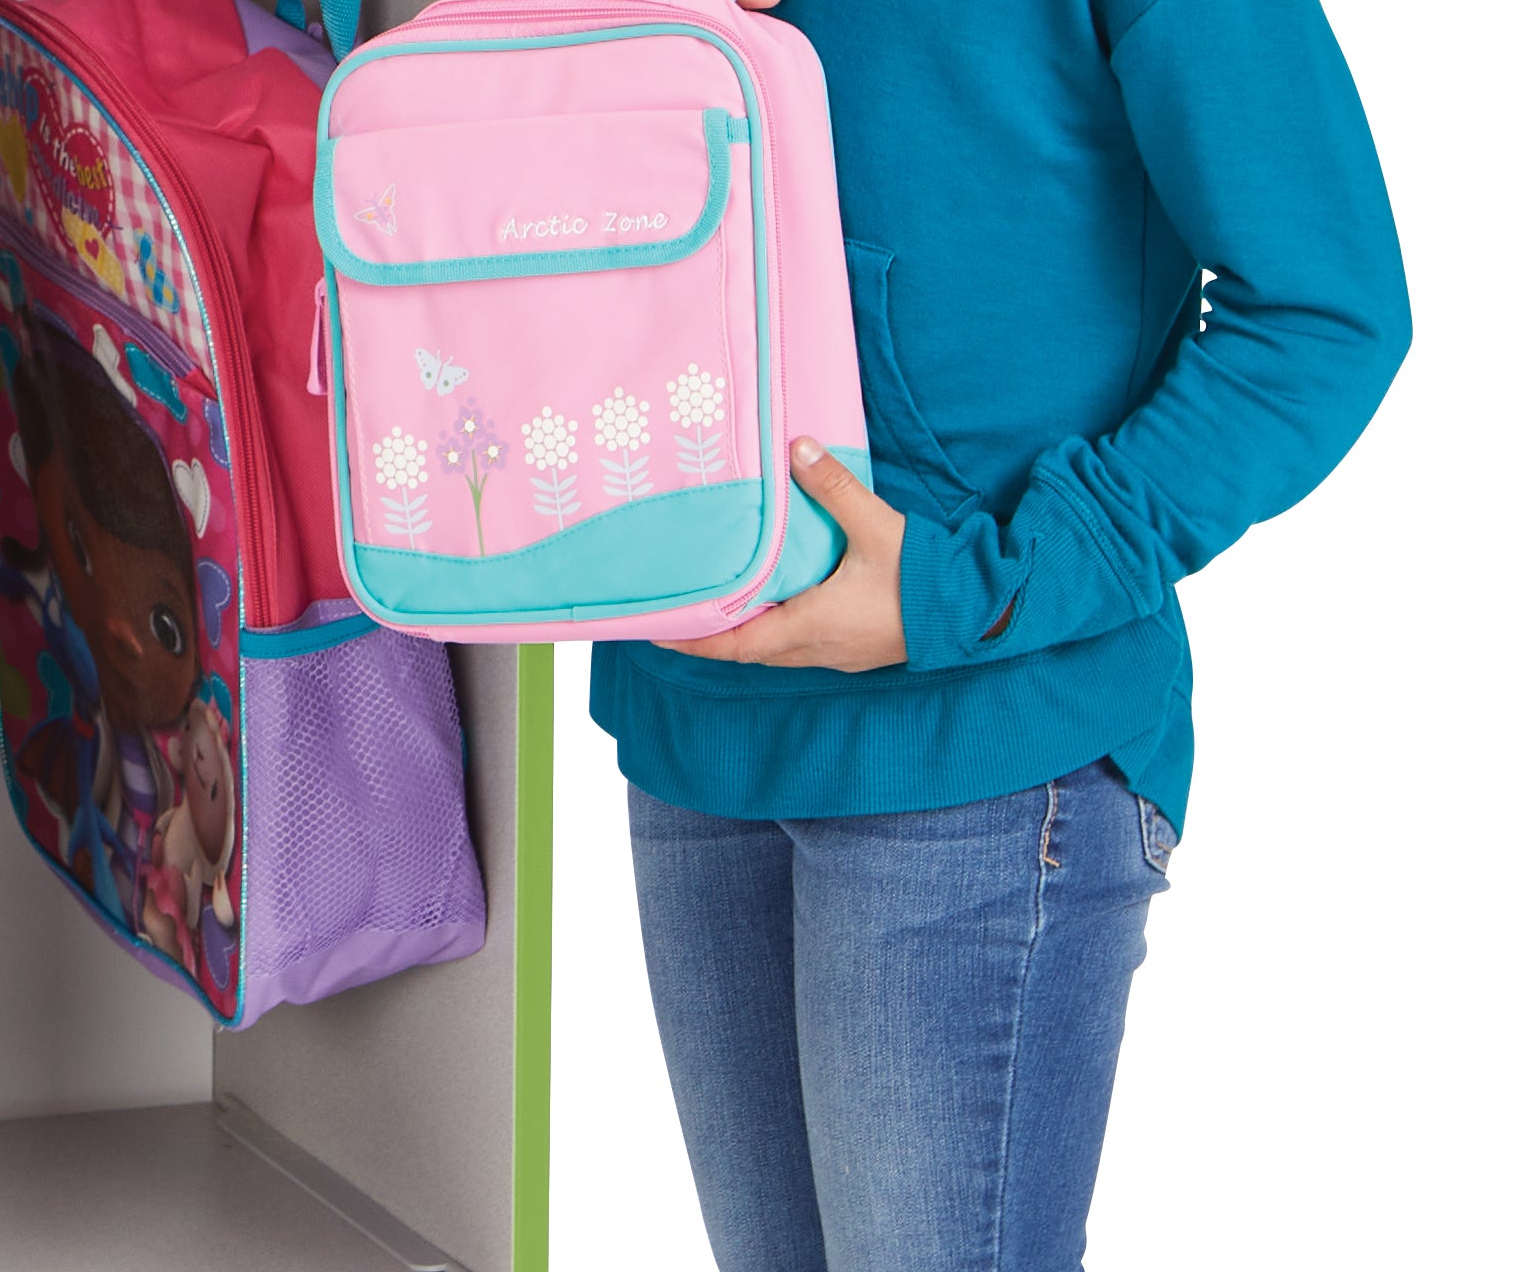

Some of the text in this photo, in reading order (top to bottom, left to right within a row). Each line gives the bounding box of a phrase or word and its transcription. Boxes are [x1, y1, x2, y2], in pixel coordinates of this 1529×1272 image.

[53, 138, 77, 177] the
[73, 155, 108, 190] best
[502, 211, 669, 240] Arctic Zone
